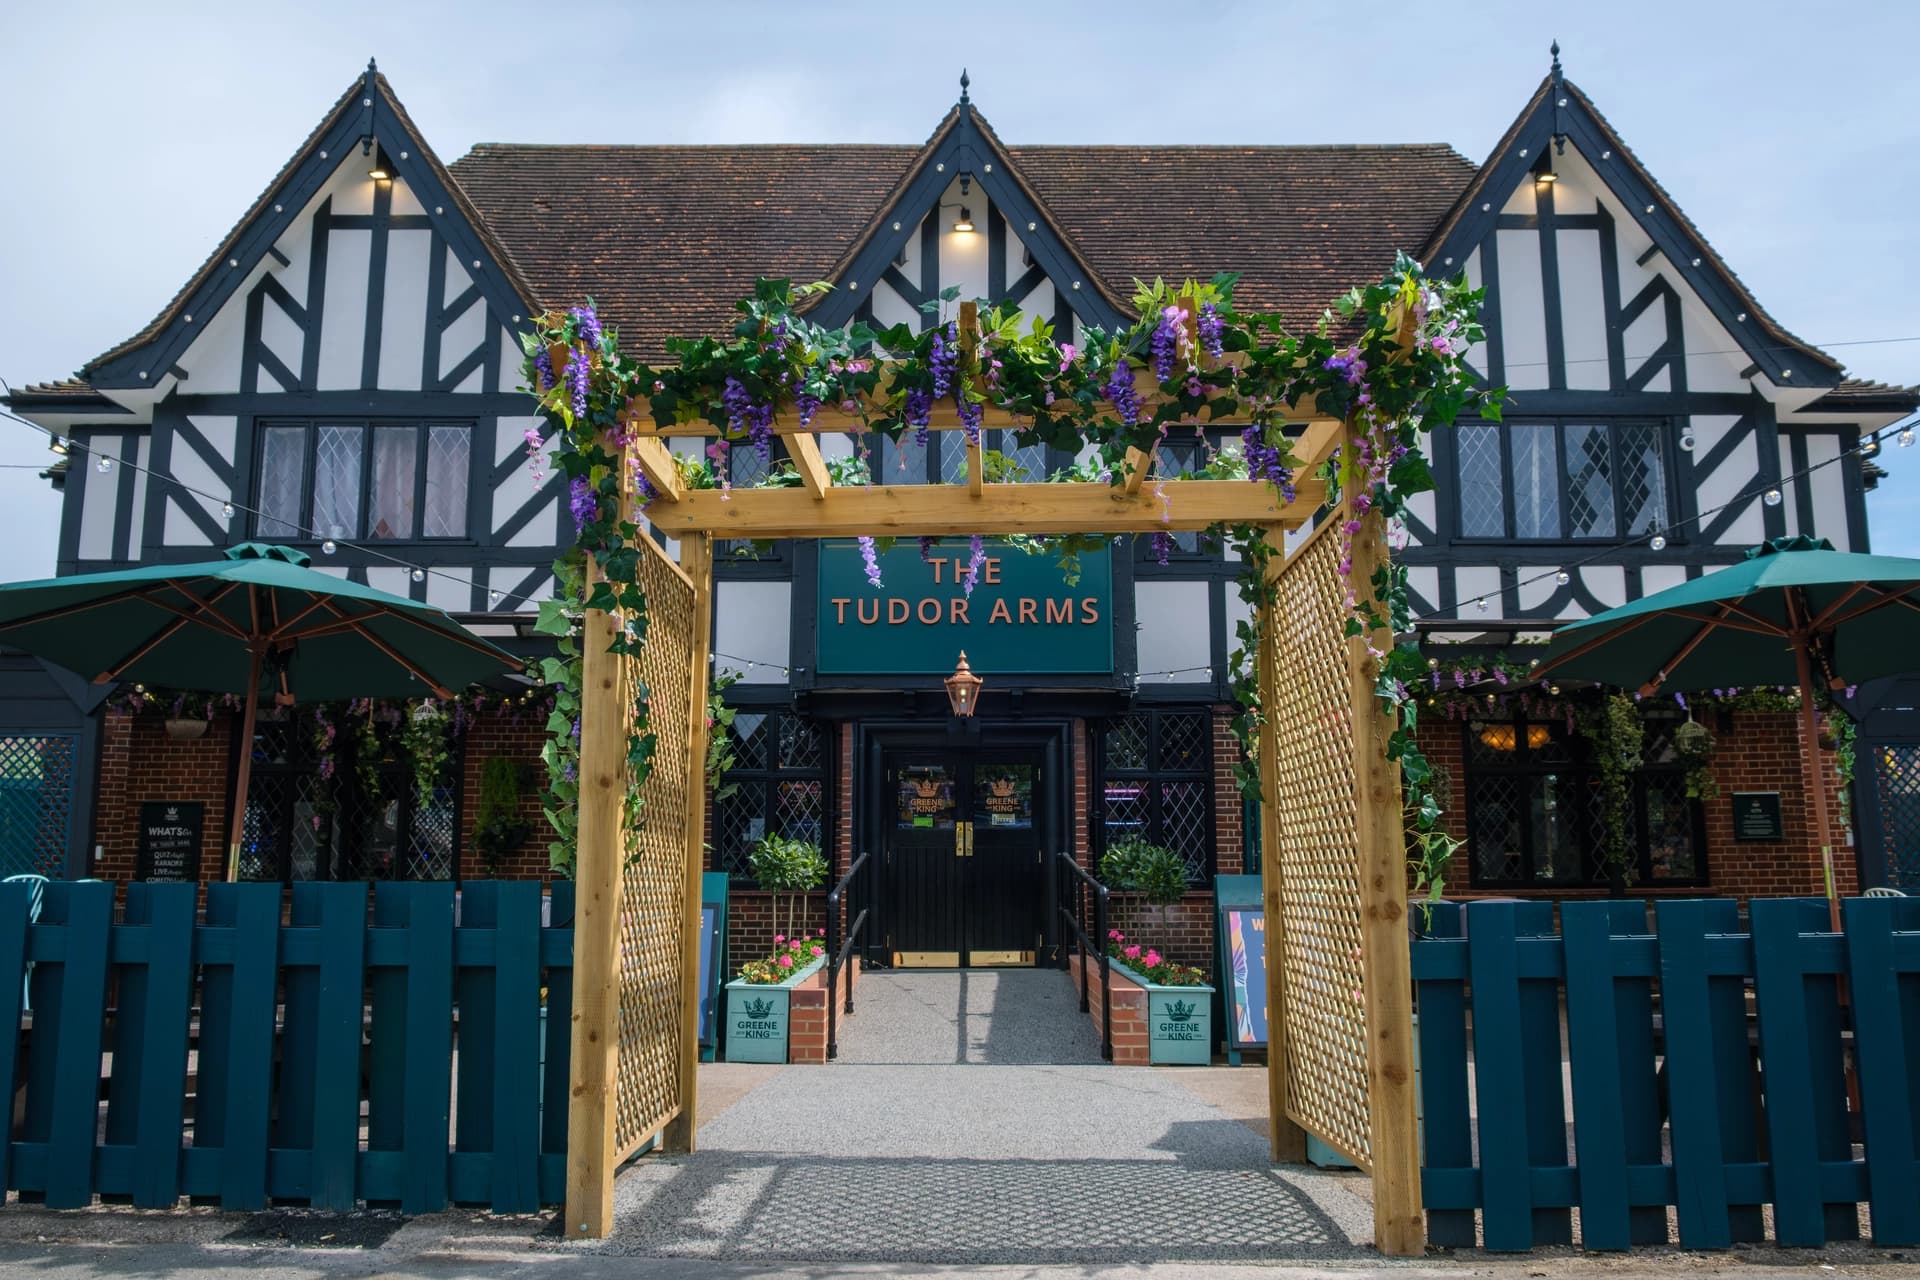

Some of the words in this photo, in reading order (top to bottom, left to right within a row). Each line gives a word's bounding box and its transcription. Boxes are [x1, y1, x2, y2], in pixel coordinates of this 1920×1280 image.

[927, 557, 1001, 585] THE
[832, 598, 971, 625] TUDOR
[989, 598, 1099, 625] ARMS
[737, 1021, 777, 1030] GREENE
[1160, 1023, 1199, 1032] GREENE
[745, 1030, 770, 1039] KING
[1168, 1032, 1193, 1040] KING
